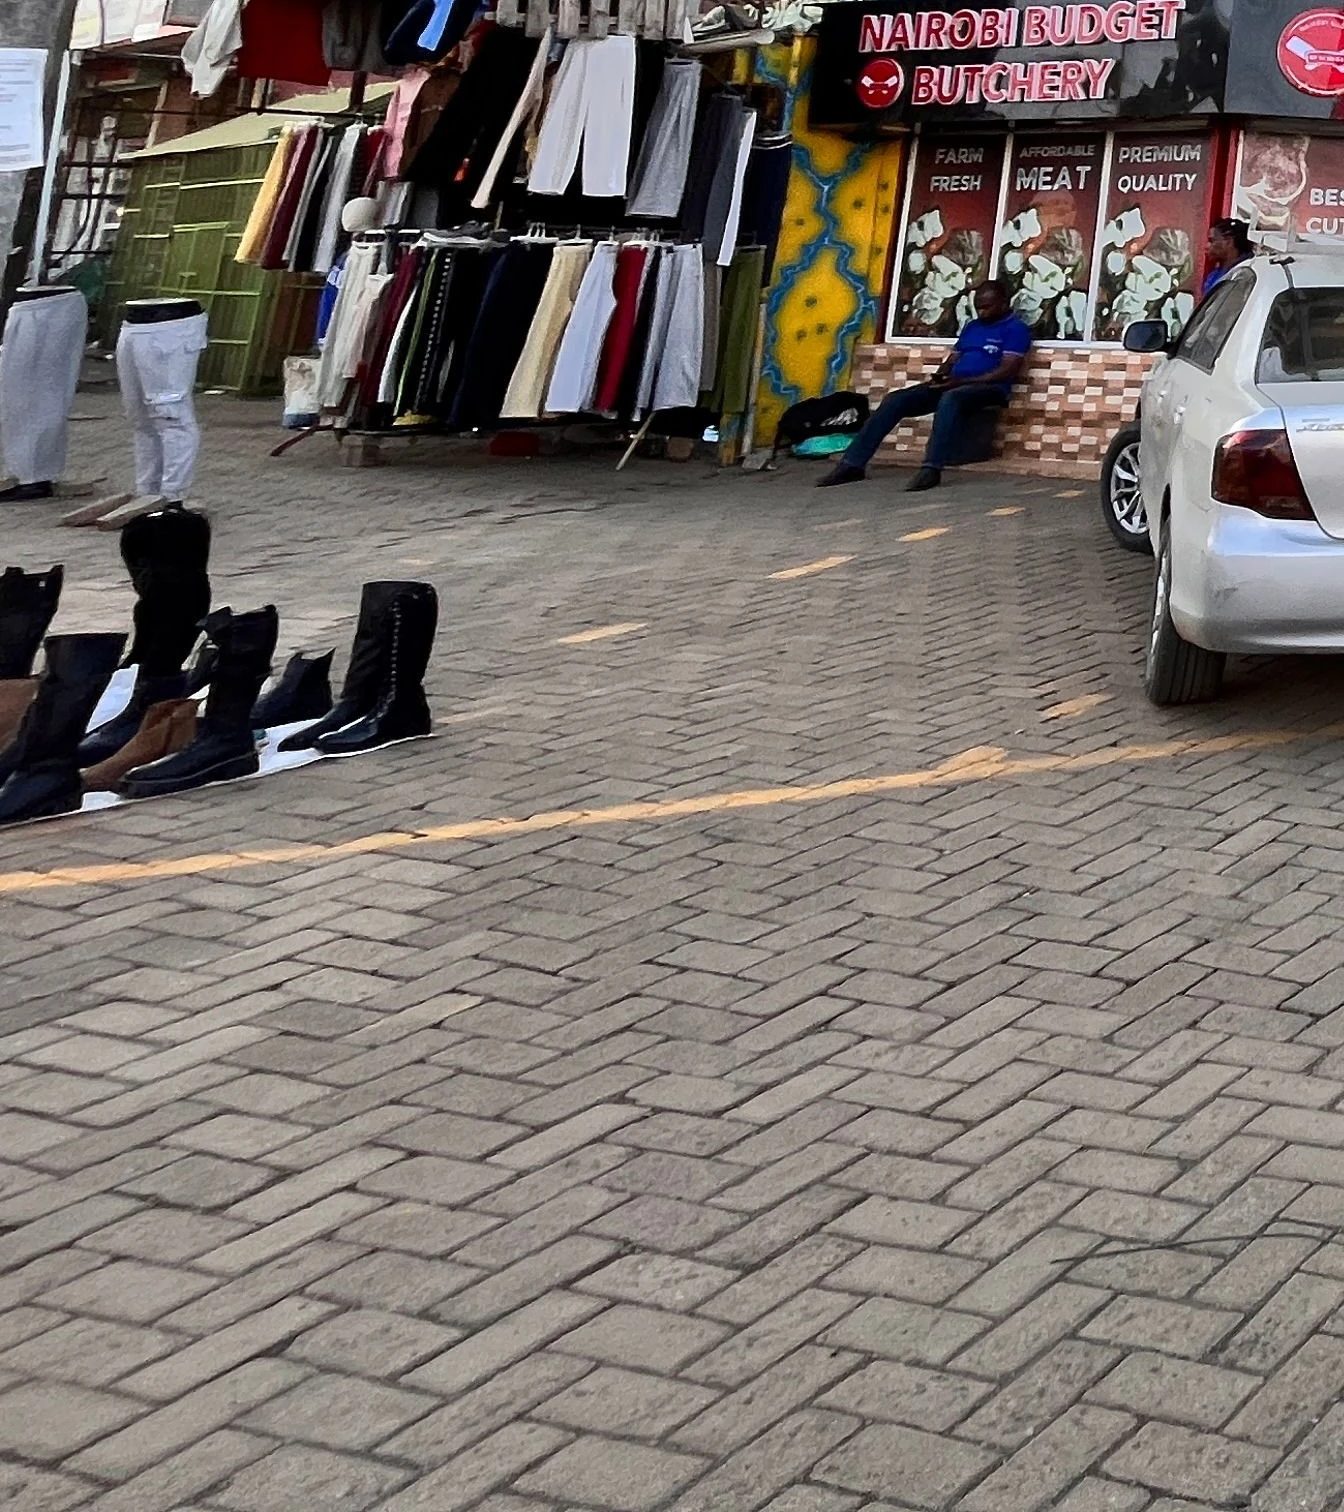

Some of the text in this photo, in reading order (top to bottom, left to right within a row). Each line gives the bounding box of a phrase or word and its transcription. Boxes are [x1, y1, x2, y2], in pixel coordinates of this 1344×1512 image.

[858, 0, 1187, 53] NAIROBI BUDGET
[911, 58, 1115, 106] BUTCHERY
[934, 147, 985, 164] FARM
[1019, 145, 1097, 159] AFFORDABLE
[1118, 144, 1202, 163] PREMIUM
[929, 174, 982, 192] FRESH
[1016, 165, 1092, 191] MEAT
[1117, 173, 1197, 194] QUALITY
